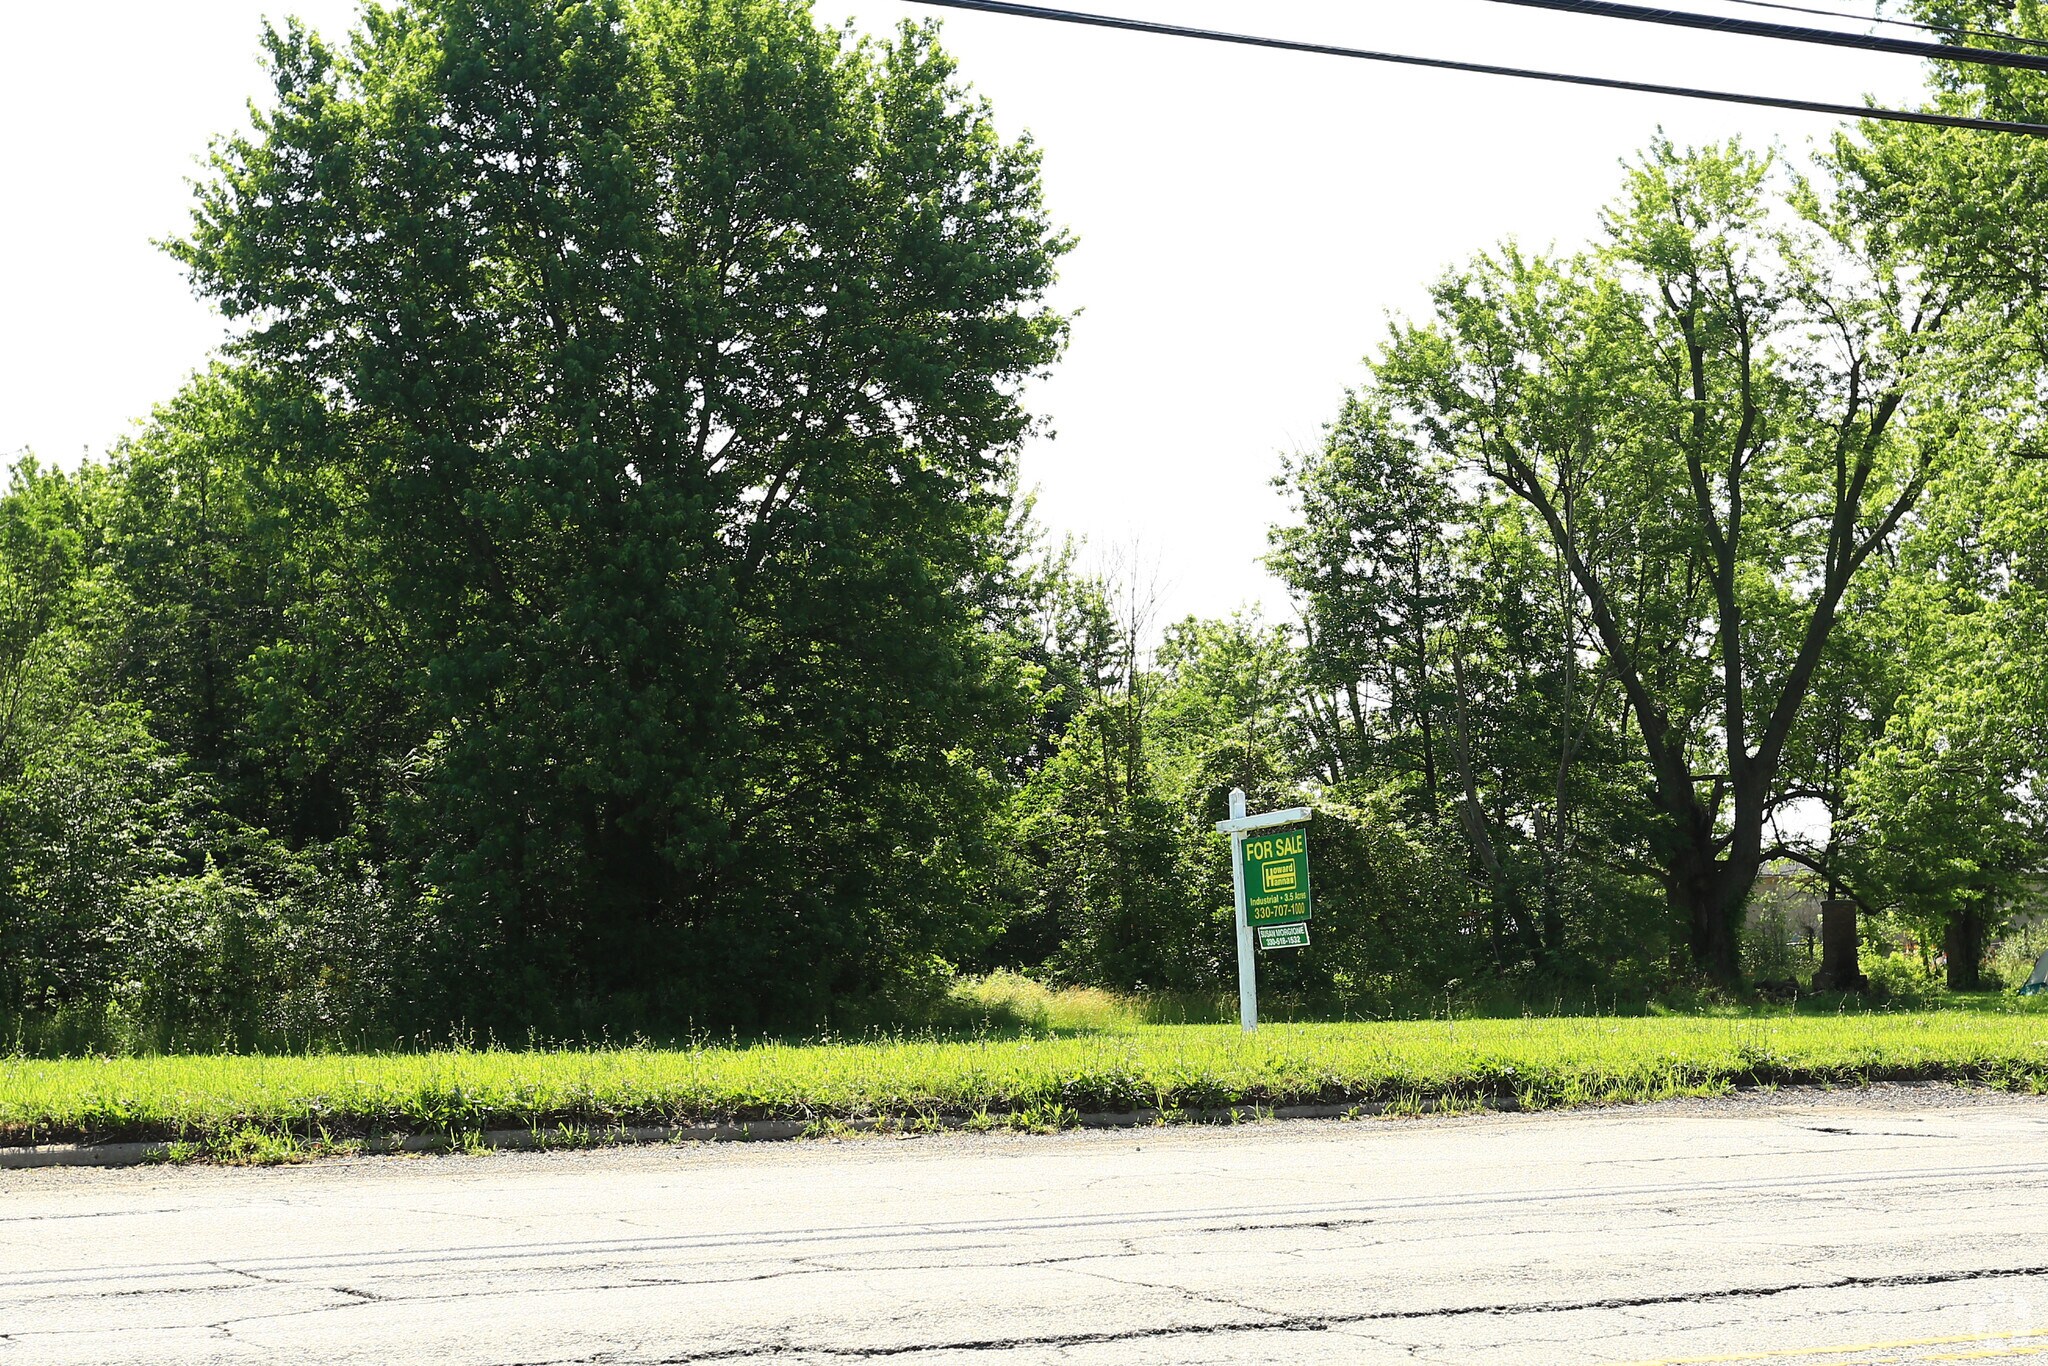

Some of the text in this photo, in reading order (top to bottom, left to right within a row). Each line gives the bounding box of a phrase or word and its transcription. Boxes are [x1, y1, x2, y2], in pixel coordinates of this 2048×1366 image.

[1246, 834, 1303, 861] FOR SALE
[1265, 863, 1293, 879] Howard
[1250, 894, 1279, 906] Industrial
[1284, 892, 1294, 902] 3.5
[1254, 902, 1305, 919] 330-707-1000
[1260, 929, 1276, 938] SUSAN
